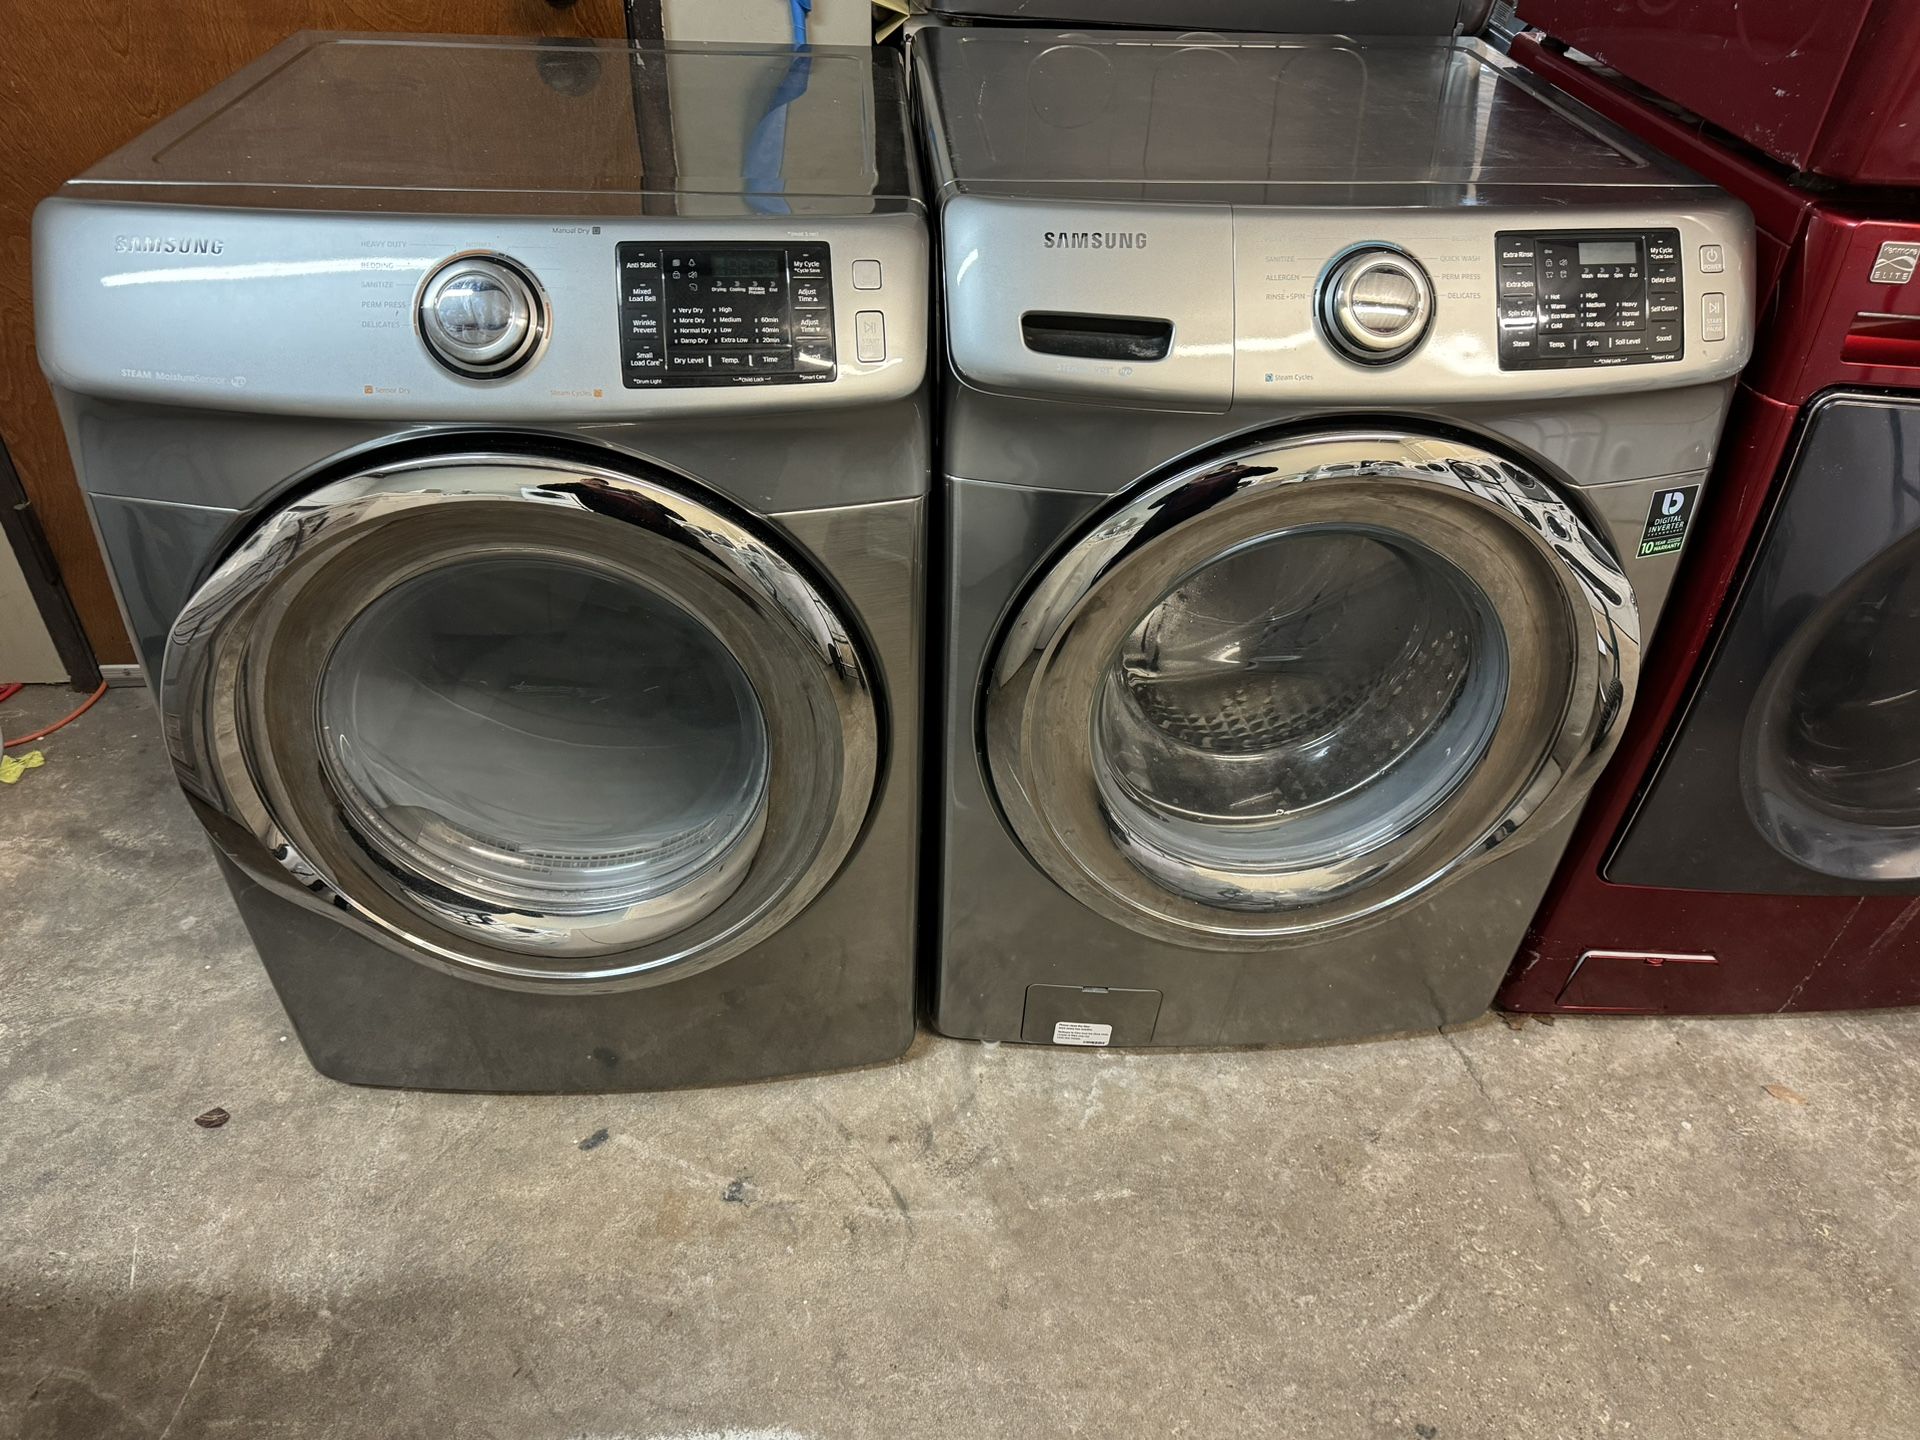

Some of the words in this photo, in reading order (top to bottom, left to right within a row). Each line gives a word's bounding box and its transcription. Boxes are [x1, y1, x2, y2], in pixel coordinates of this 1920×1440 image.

[578, 227, 590, 235] Dry
[1043, 231, 1149, 249] SAMSUNG
[115, 235, 225, 256] SAMSUNG
[1264, 255, 1297, 263] SANITIZE
[793, 260, 803, 268] My
[803, 260, 820, 268] Cycle
[1265, 273, 1300, 281] ALLERGEN
[1874, 271, 1909, 280] ELITE
[1521, 280, 1534, 288] Spin
[798, 288, 817, 296] Adjust
[719, 306, 733, 314] High
[695, 317, 706, 325] Dry
[720, 316, 742, 324] Medium
[801, 319, 819, 327] Adjust
[701, 327, 712, 335] Dry
[681, 337, 697, 345] Damp
[697, 337, 709, 345] Dry
[674, 357, 687, 365] Dry
[721, 356, 740, 364] Temp.
[121, 369, 151, 379] STEAM
[1295, 373, 1314, 382] Cycles
[399, 387, 411, 395] Dry
[1654, 515, 1682, 525] DIGITAL
[1648, 521, 1685, 533] INVERTER
[1641, 541, 1654, 555] 10
[1654, 542, 1681, 551] WARRANTY
